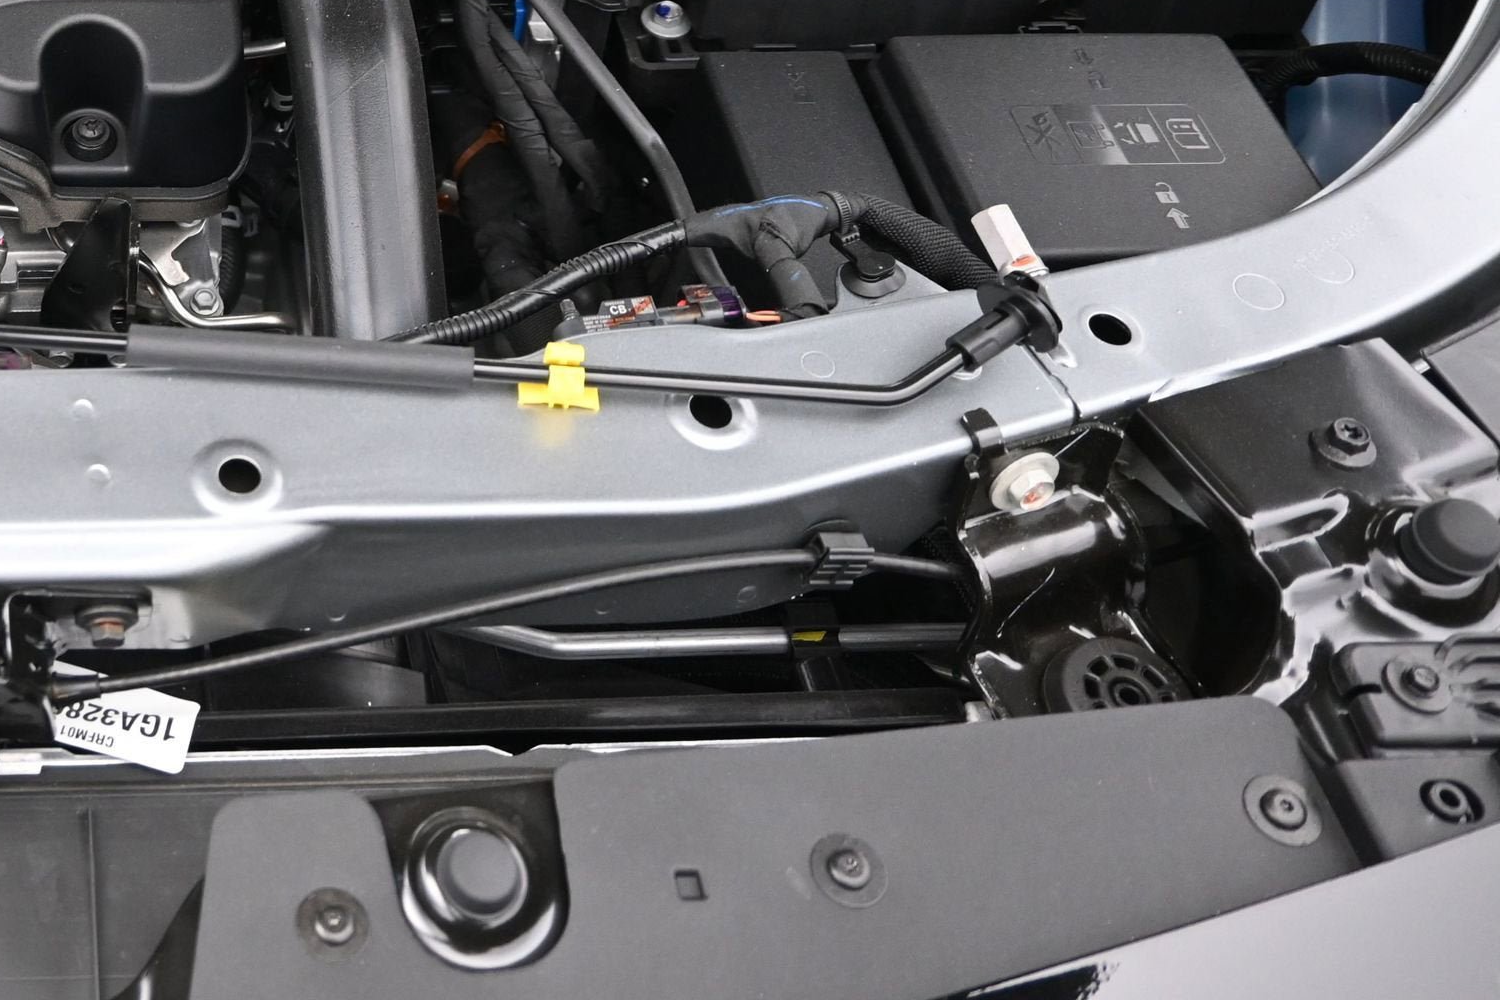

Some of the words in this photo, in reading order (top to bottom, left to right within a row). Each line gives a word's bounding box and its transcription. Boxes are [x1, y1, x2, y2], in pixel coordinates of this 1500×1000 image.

[610, 305, 627, 315] CB
[54, 700, 176, 741] 1GA328
[60, 725, 114, 748] CRFM01
